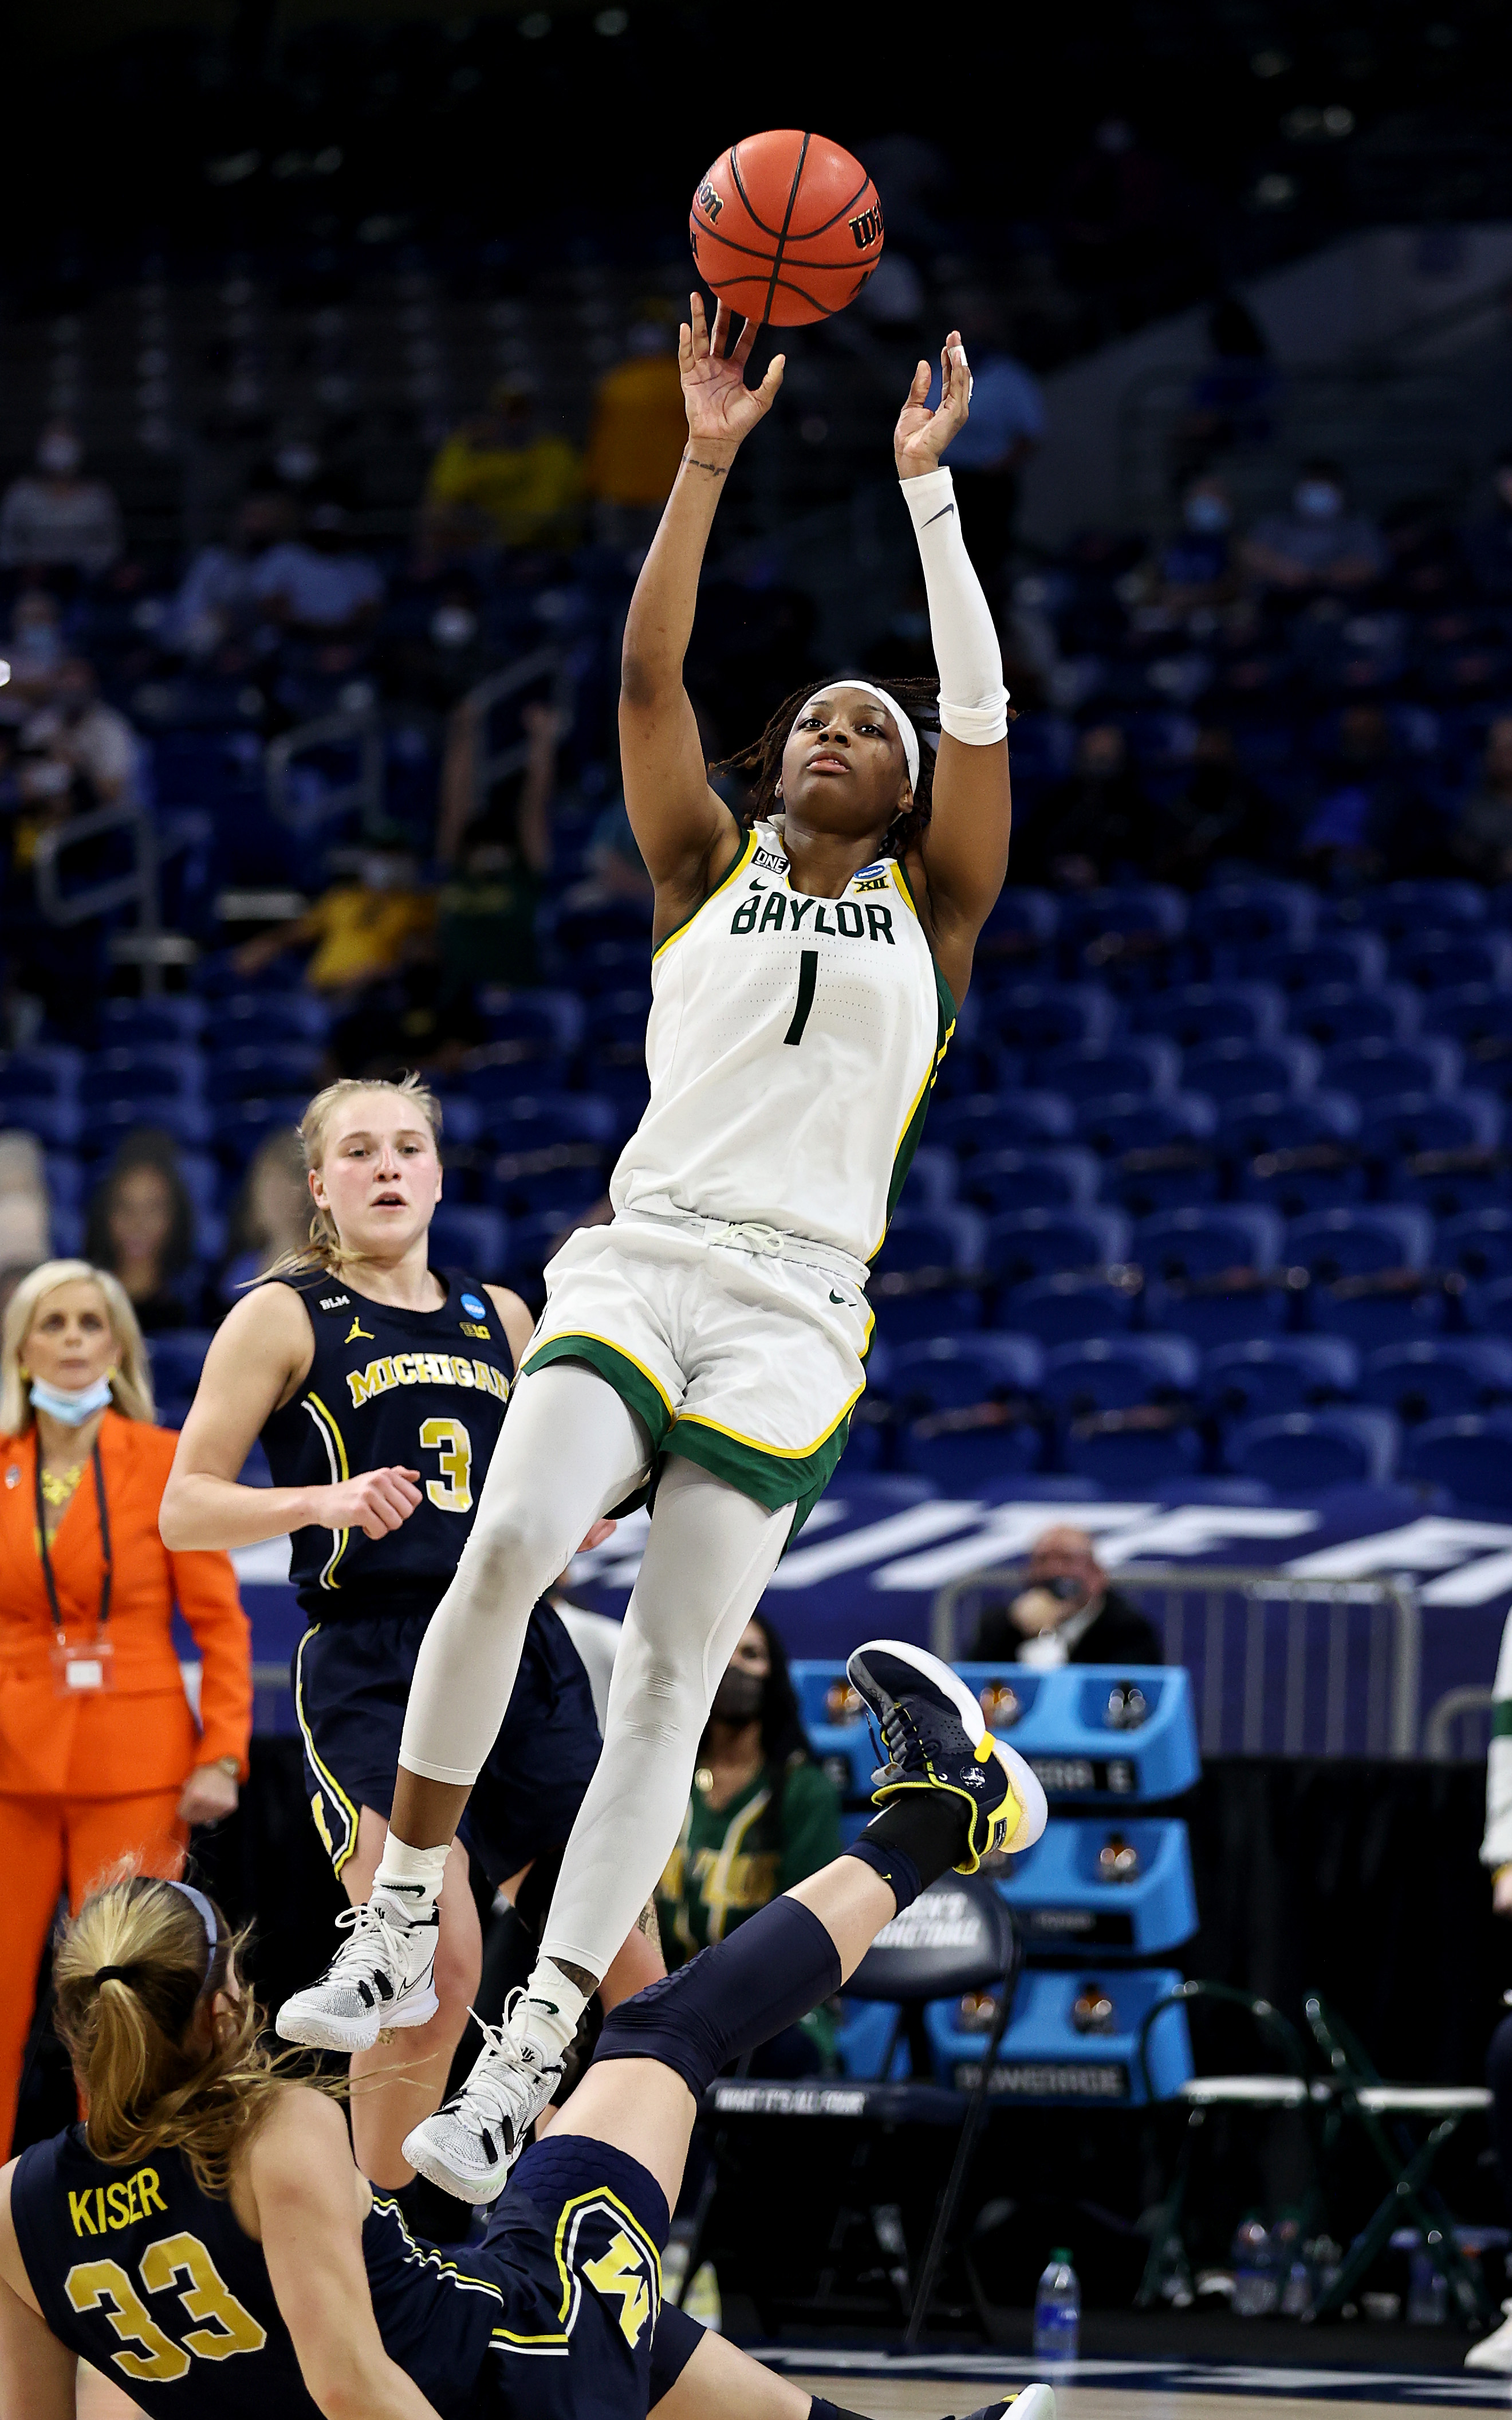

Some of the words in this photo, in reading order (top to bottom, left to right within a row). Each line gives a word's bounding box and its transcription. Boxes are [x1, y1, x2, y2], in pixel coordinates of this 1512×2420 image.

[756, 850, 786, 871] ONE
[853, 874, 889, 893] XII
[730, 891, 896, 945] BAYLOR
[783, 950, 819, 1046] 1
[319, 1295, 351, 1310] BLM
[346, 1353, 510, 1409] MICHIGAN
[419, 1417, 474, 1513] 3
[68, 2167, 168, 2237] KISER
[64, 2231, 267, 2383] 33
